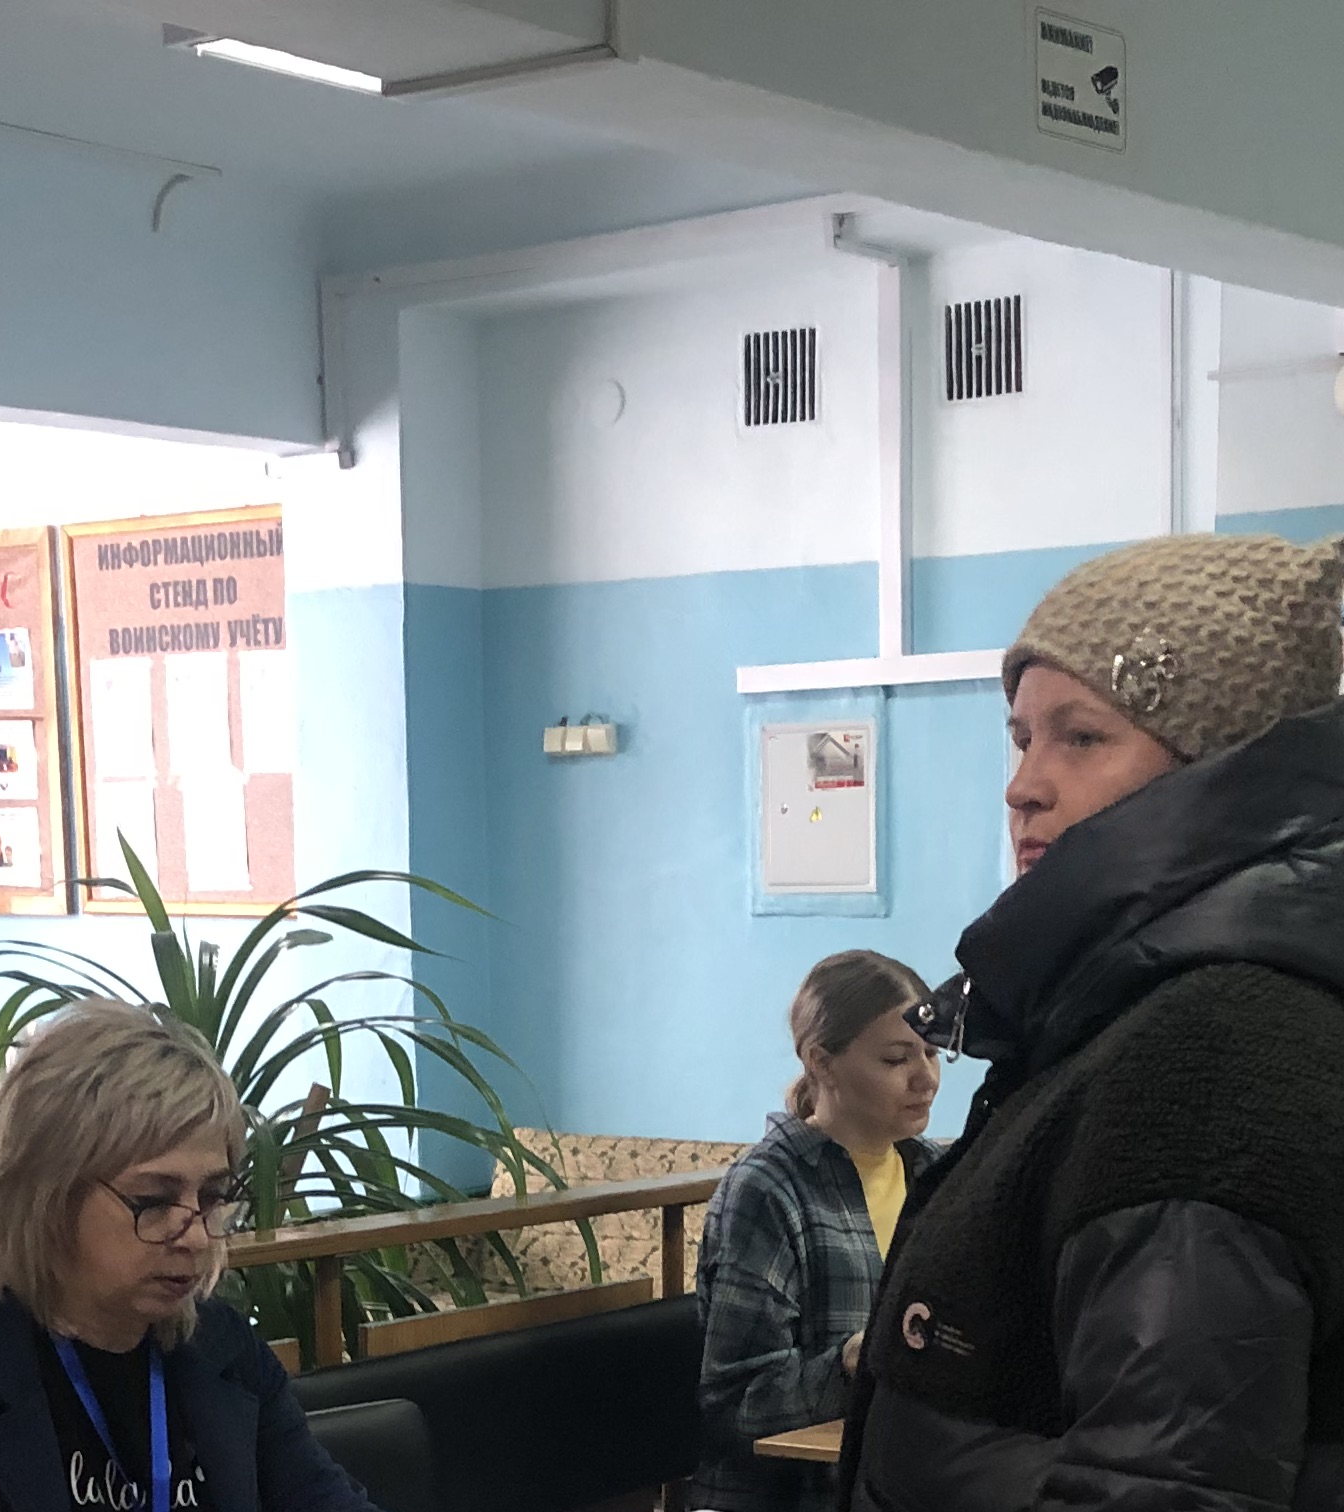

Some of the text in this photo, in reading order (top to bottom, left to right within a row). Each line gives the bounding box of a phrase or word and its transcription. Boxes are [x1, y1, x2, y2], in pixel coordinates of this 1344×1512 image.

[97, 523, 284, 572] ИНФОРМАЦИОННЫЙ
[150, 576, 238, 611] СТЕНД ПО
[108, 614, 284, 656] ВОИНСКОМУ УЧЁТУ
